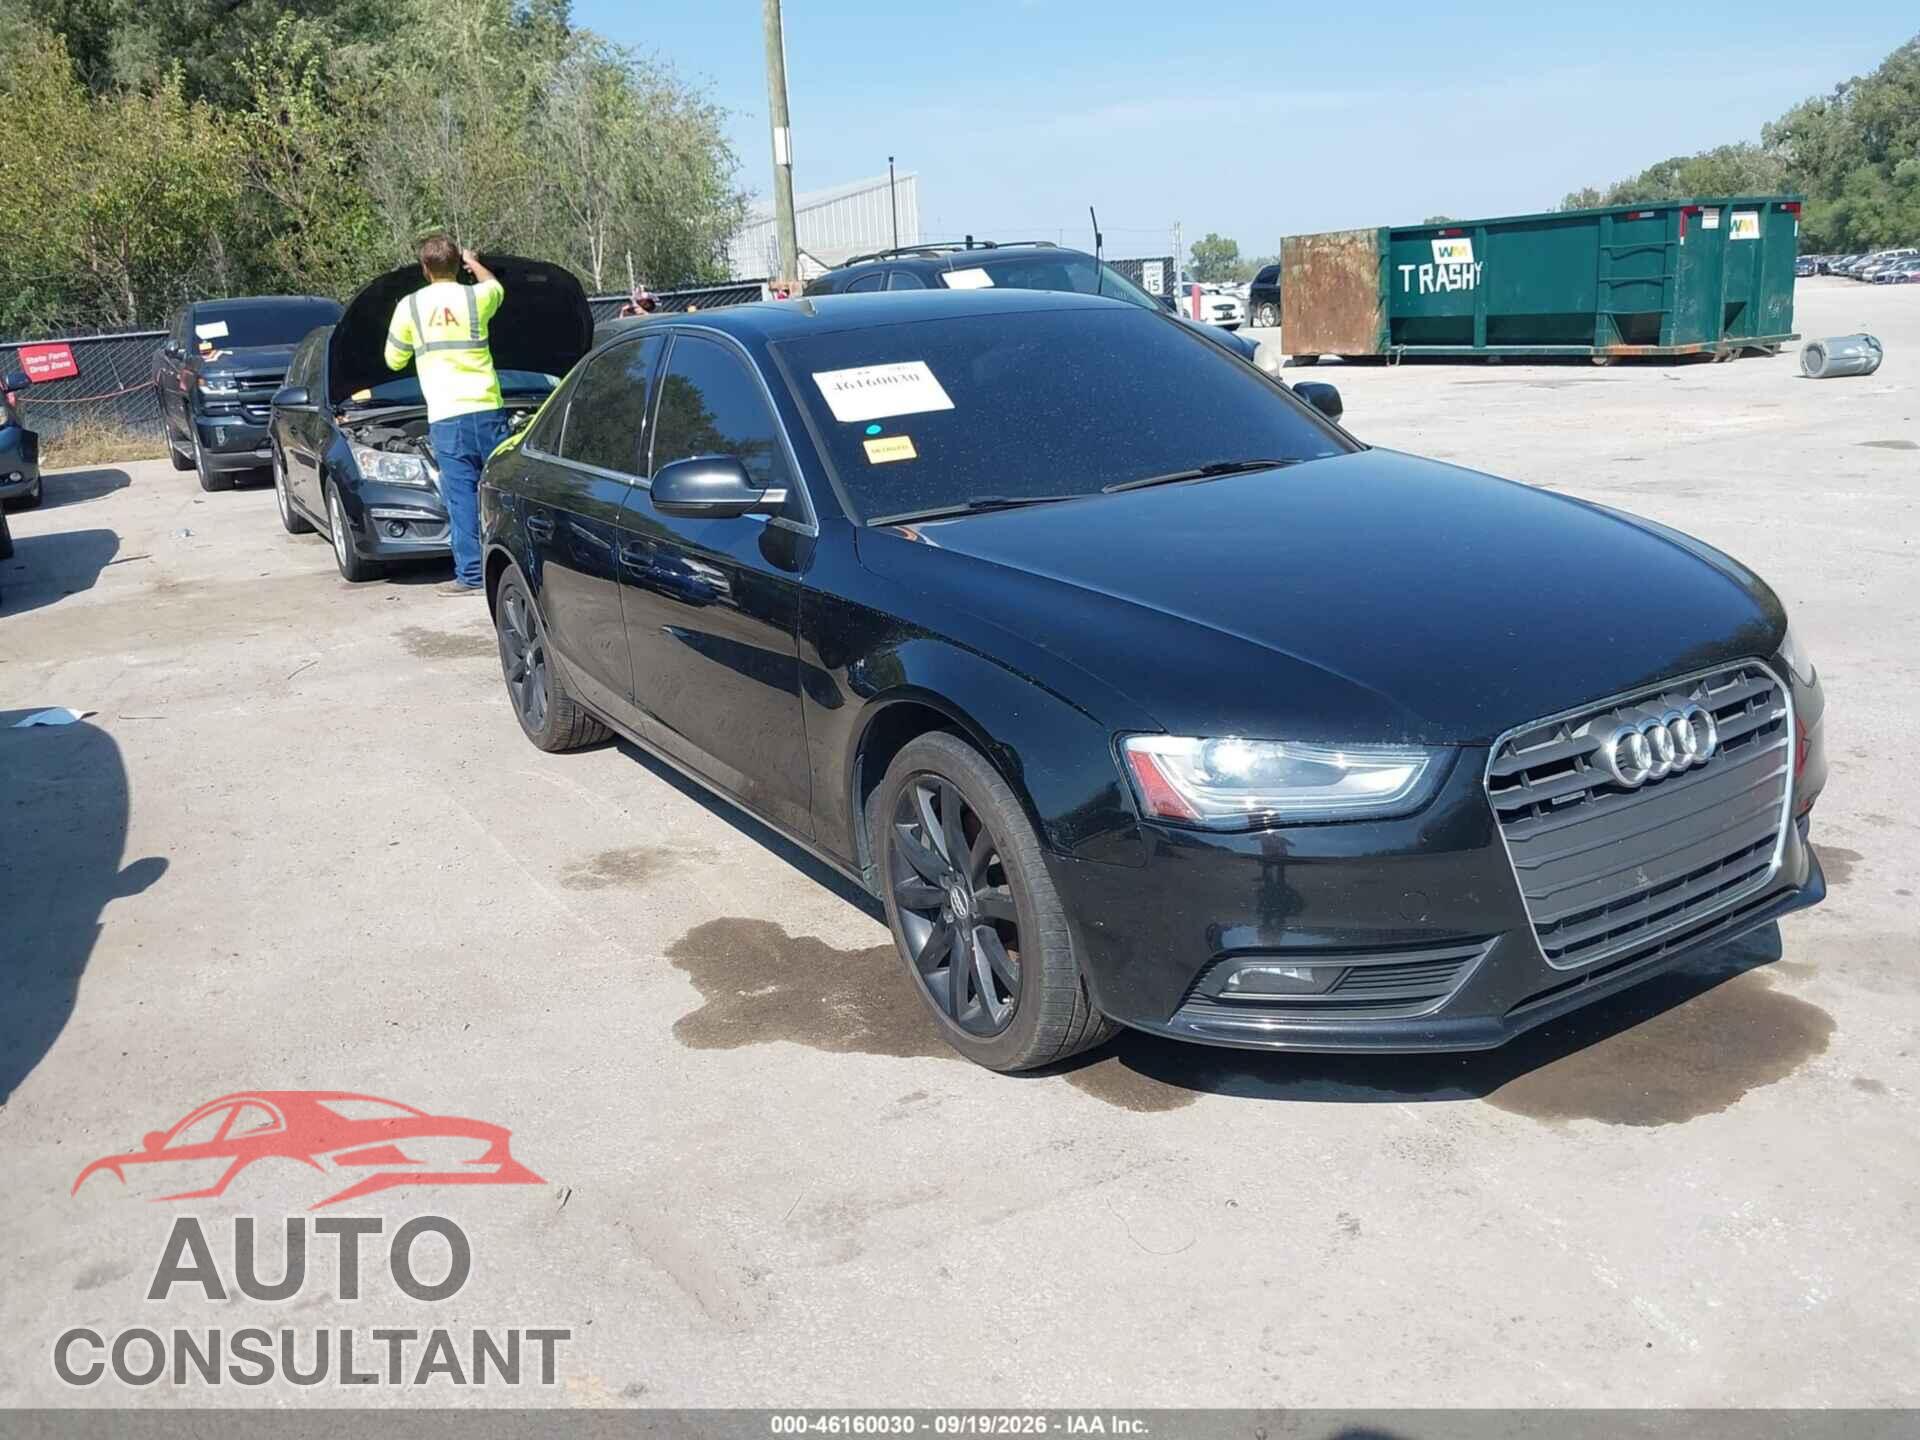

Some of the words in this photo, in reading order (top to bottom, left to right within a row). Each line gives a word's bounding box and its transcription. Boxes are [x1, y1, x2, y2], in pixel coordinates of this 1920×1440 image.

[1438, 246, 1468, 257] WM
[1397, 261, 1483, 294] TRASHY
[1147, 279, 1160, 292] 15
[26, 355, 47, 365] State
[48, 351, 69, 361] Farm
[29, 365, 50, 374] Drop
[51, 361, 71, 370] Zone
